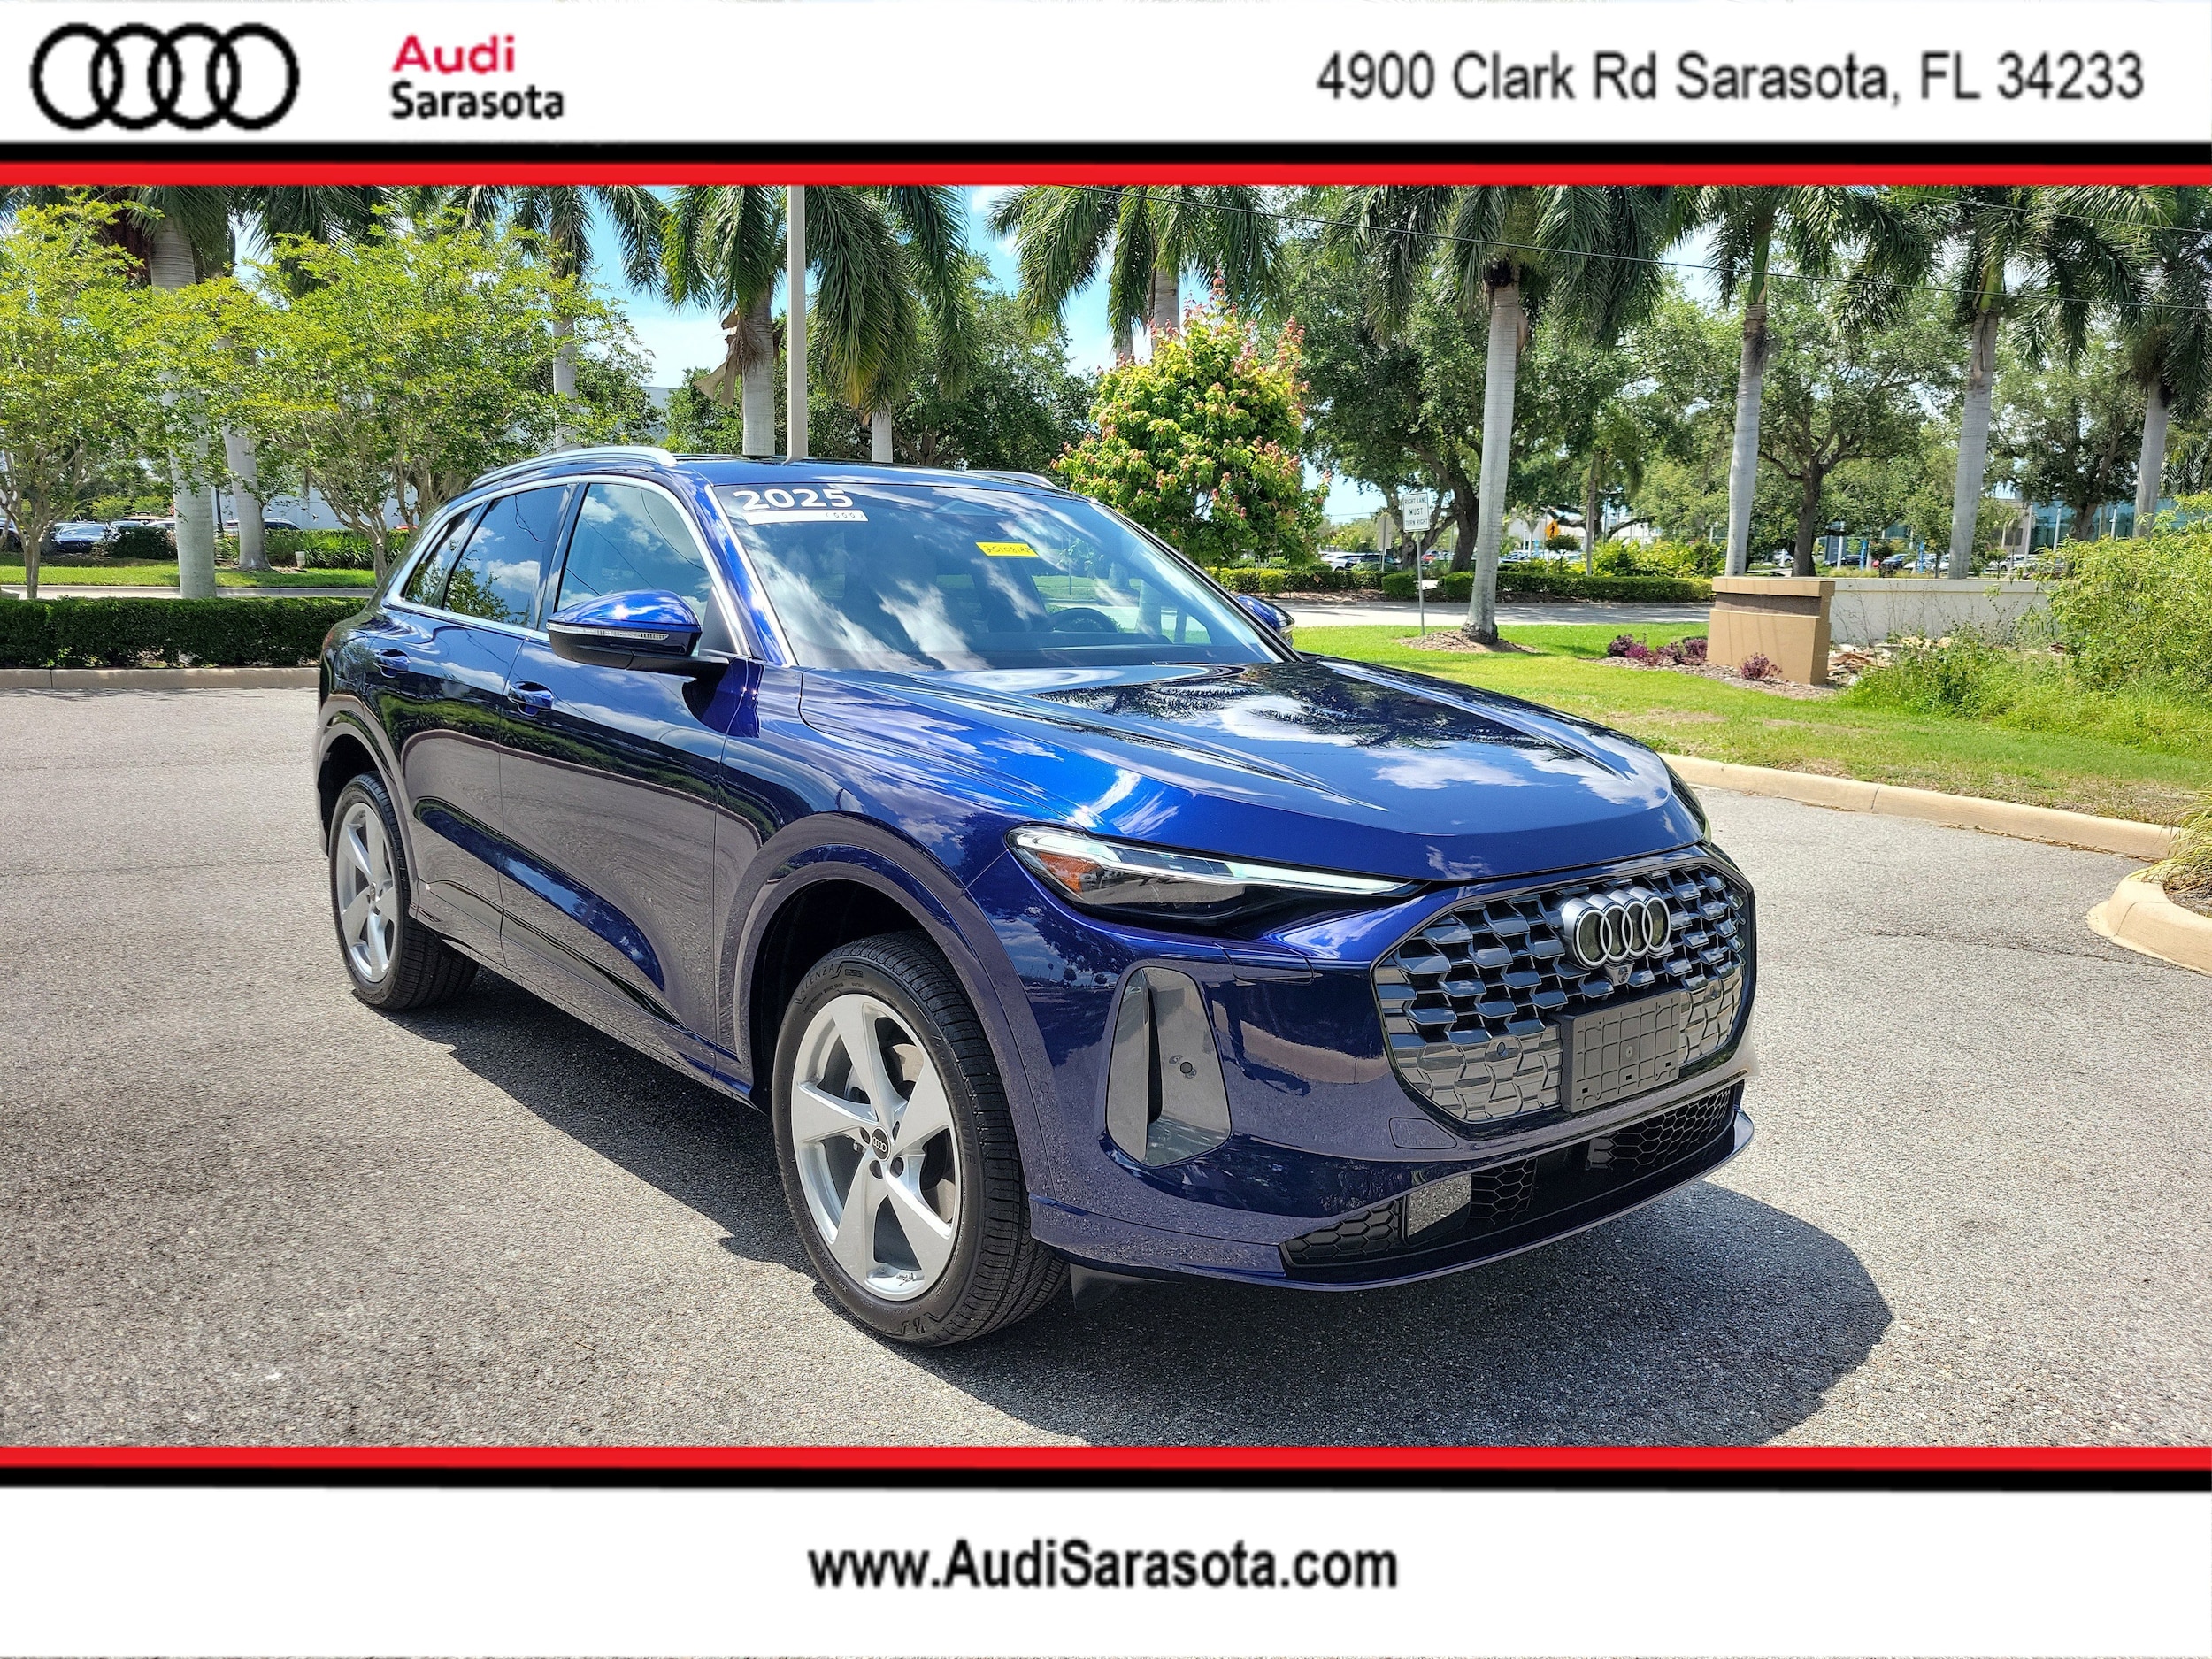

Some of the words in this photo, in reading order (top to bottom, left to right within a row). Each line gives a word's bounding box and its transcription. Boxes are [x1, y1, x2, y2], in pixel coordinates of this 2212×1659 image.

[733, 488, 854, 511] 2025
[1409, 507, 1424, 516] MUST
[799, 963, 835, 996] ALENZA
